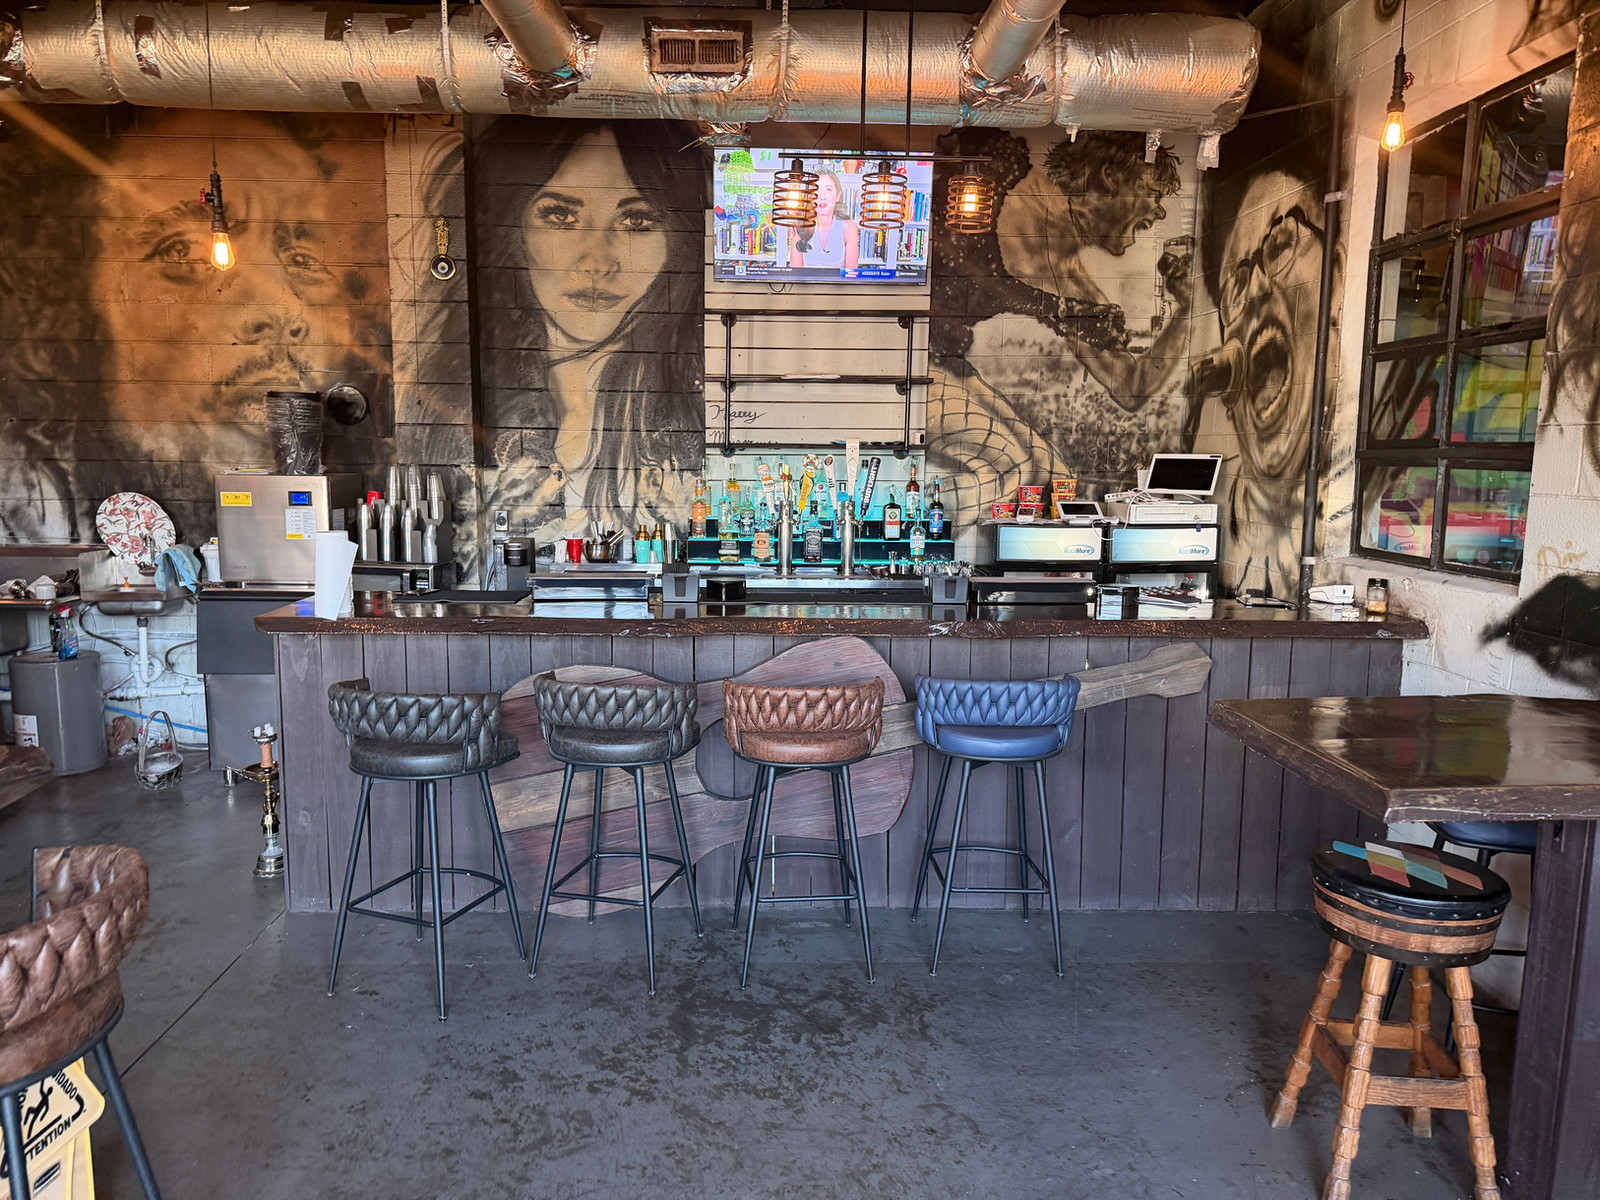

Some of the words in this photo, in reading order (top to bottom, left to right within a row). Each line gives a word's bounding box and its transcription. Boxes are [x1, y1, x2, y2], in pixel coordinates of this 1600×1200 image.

[863, 488, 872, 503] BUD
[868, 465, 878, 488] LIGHT
[54, 1070, 78, 1100] IDADO
[25, 1116, 71, 1160] TENTION
